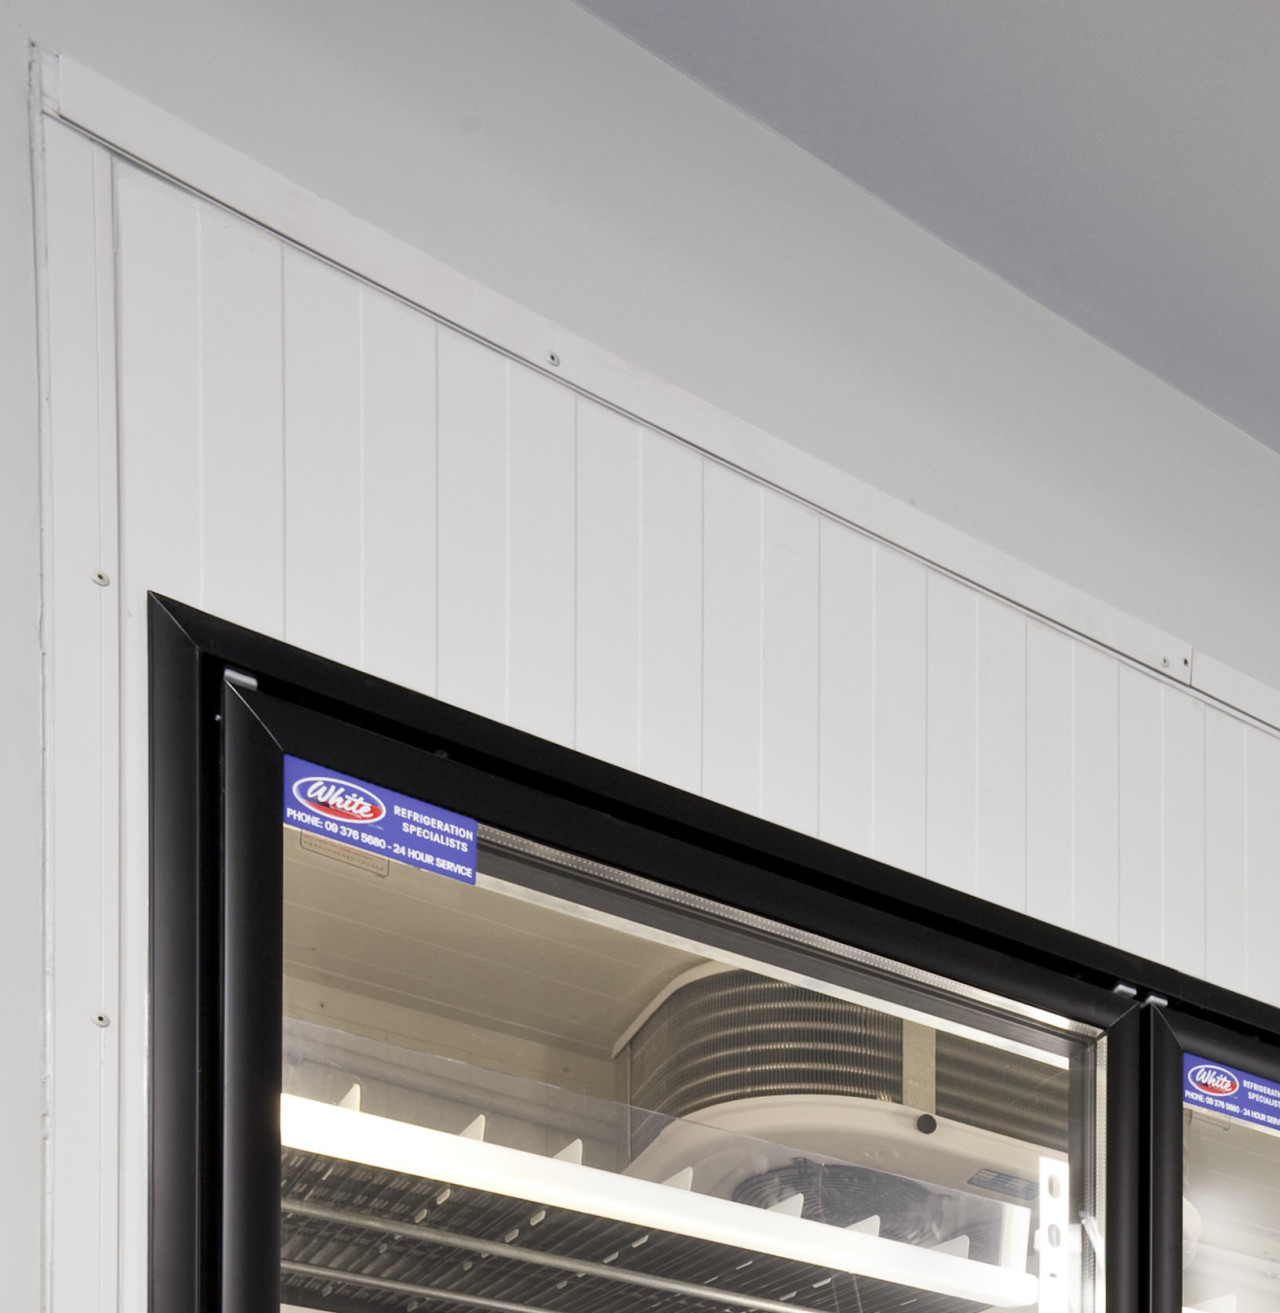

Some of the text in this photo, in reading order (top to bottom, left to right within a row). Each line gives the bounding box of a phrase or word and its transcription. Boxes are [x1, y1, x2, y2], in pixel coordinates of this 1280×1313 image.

[307, 781, 374, 818] White
[394, 805, 473, 841] REFRIGERATION
[402, 822, 468, 852] SPECIALISTS
[286, 807, 324, 829] PHONE:
[324, 821, 338, 833] 09
[393, 843, 406, 856] 24
[407, 848, 434, 866] HOUR
[435, 857, 473, 878] SERVICE
[1195, 1068, 1233, 1091] White
